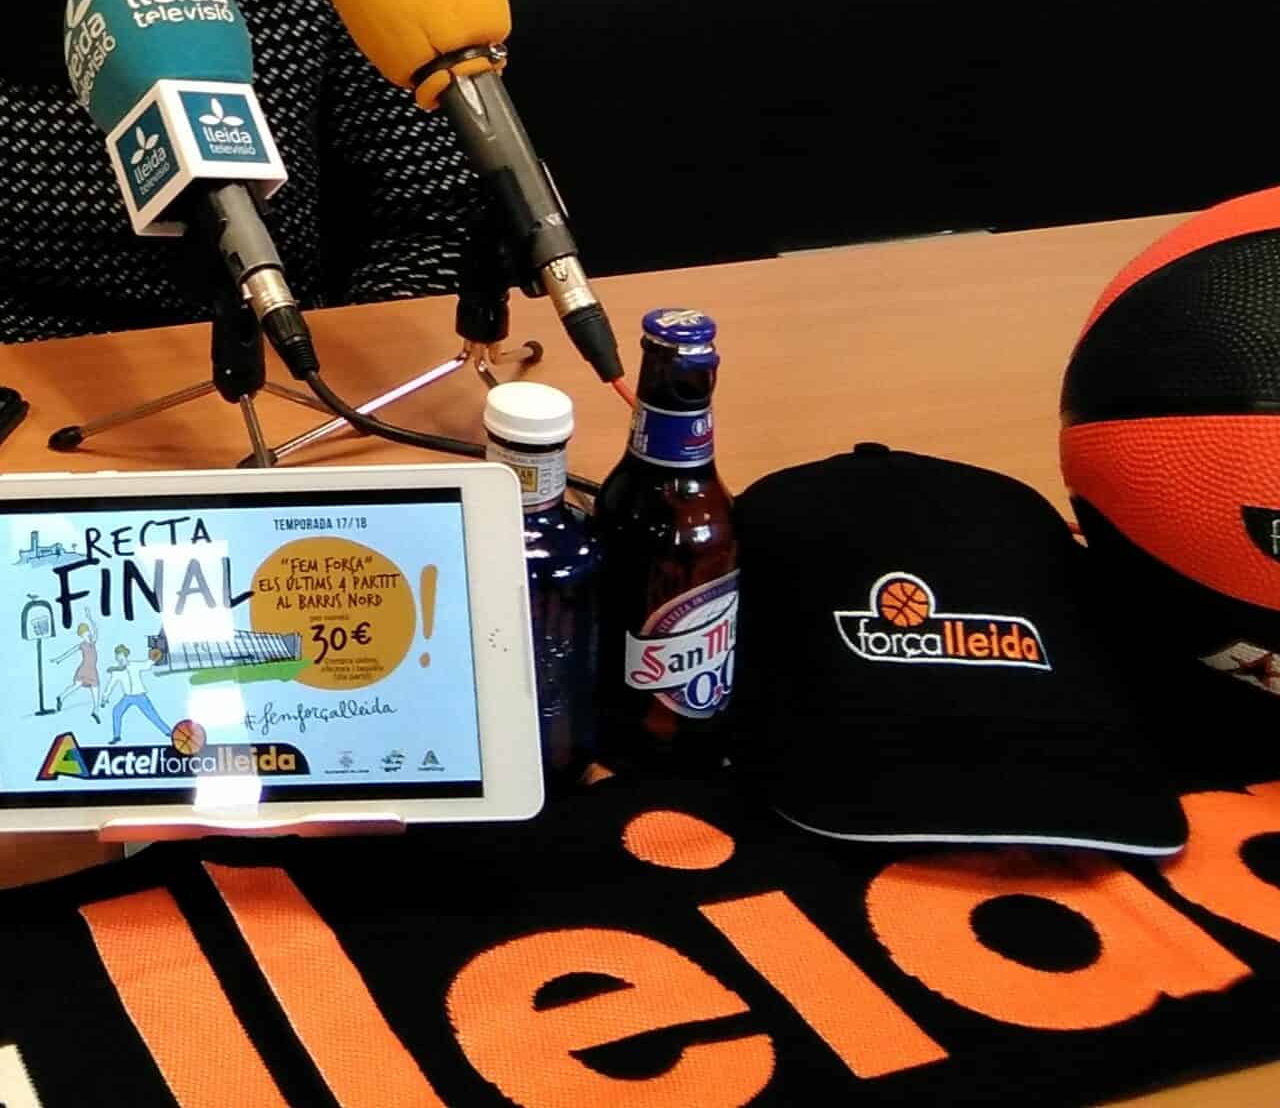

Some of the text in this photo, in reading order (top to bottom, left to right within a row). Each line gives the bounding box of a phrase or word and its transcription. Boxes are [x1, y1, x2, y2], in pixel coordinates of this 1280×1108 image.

[202, 126, 252, 143] lleida
[134, 147, 167, 184] lleida
[274, 517, 367, 531] TEMPORADA 17/18
[85, 517, 212, 560] RECTA
[53, 557, 255, 629] FINAL
[259, 579, 281, 592] ELS
[276, 596, 292, 609] AL
[299, 593, 341, 609] BARRIS
